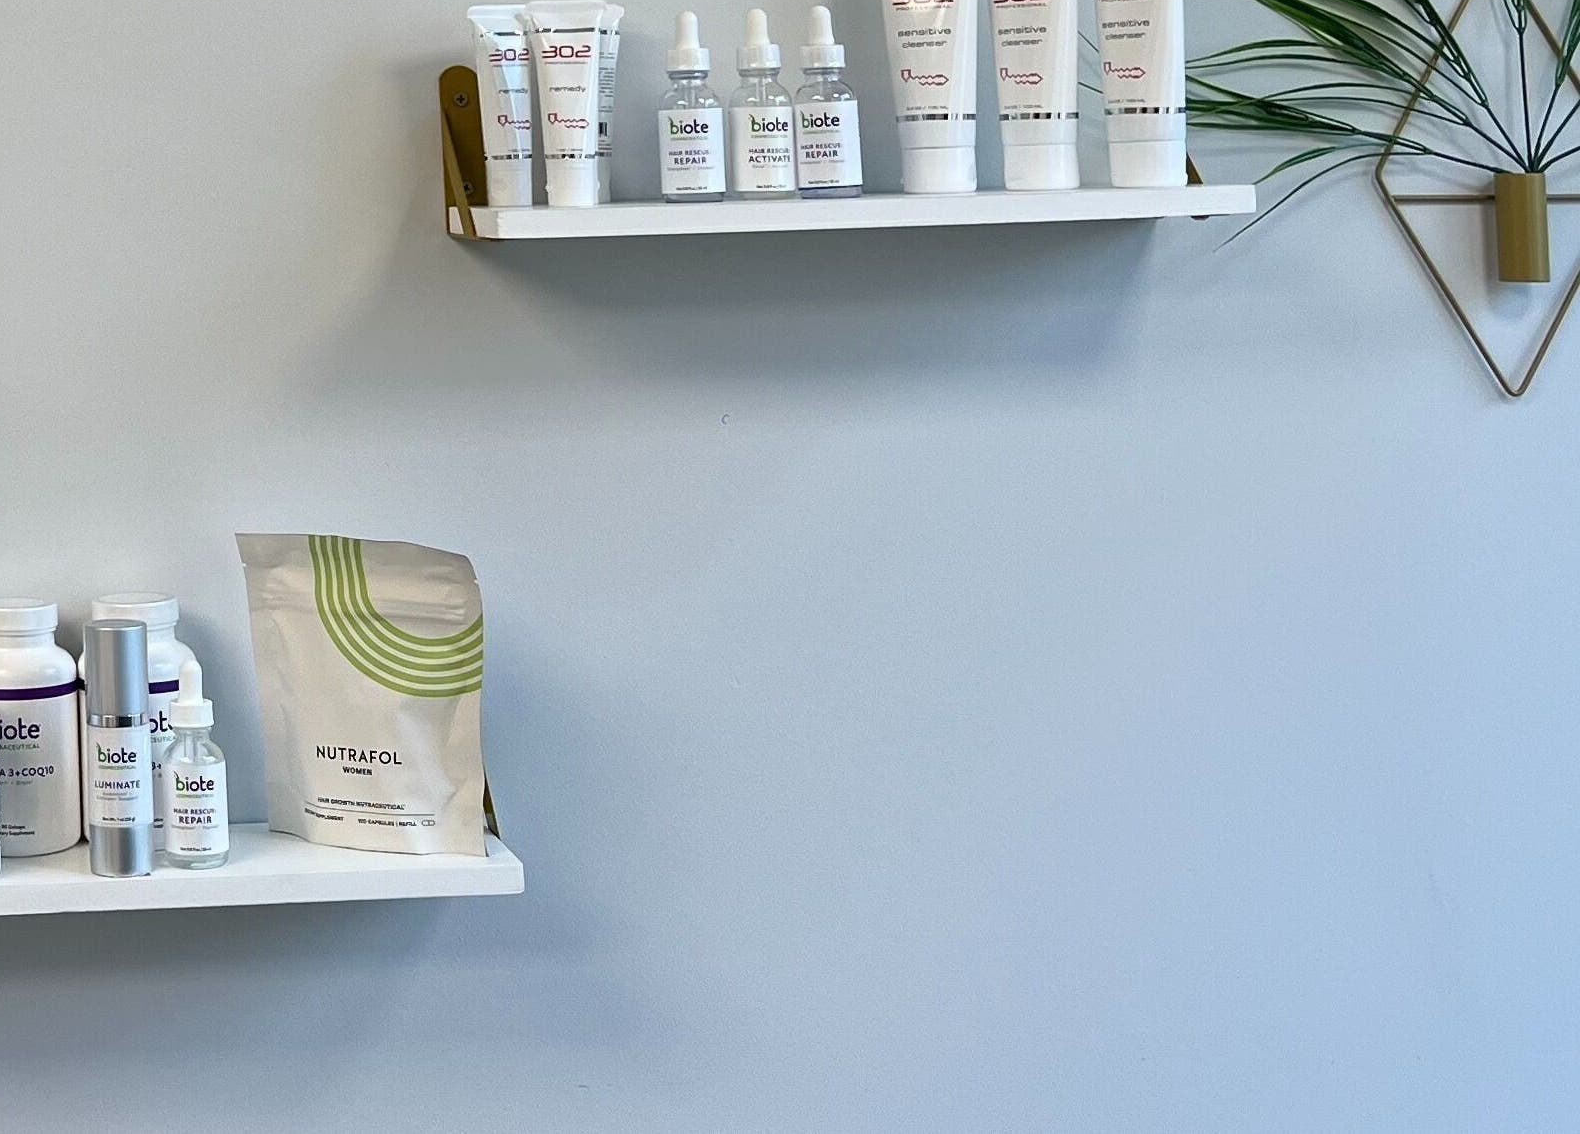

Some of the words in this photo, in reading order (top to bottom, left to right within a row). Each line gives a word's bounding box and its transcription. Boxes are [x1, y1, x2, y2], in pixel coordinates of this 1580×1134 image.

[1101, 19, 1151, 29] sensitive
[897, 27, 953, 38] sensitive
[997, 25, 1048, 36] sensitive
[1104, 31, 1147, 41] cleanser
[901, 39, 949, 49] cleanser
[1001, 37, 1044, 47] cleanser
[488, 47, 530, 62] 302
[541, 44, 592, 59] 302
[498, 86, 529, 96] remedy
[548, 84, 587, 94] remedy
[748, 114, 789, 133] biote
[800, 109, 841, 129] biote
[667, 116, 709, 135] biote
[805, 149, 839, 159] REPAIR
[673, 156, 708, 166] REPAIR
[96, 741, 137, 764] biote
[316, 745, 403, 766] NUTRAFOL
[342, 765, 373, 776] WOMEN
[94, 779, 141, 789] LUMINATE
[174, 770, 215, 792] biote
[178, 815, 212, 825] REPAIR
